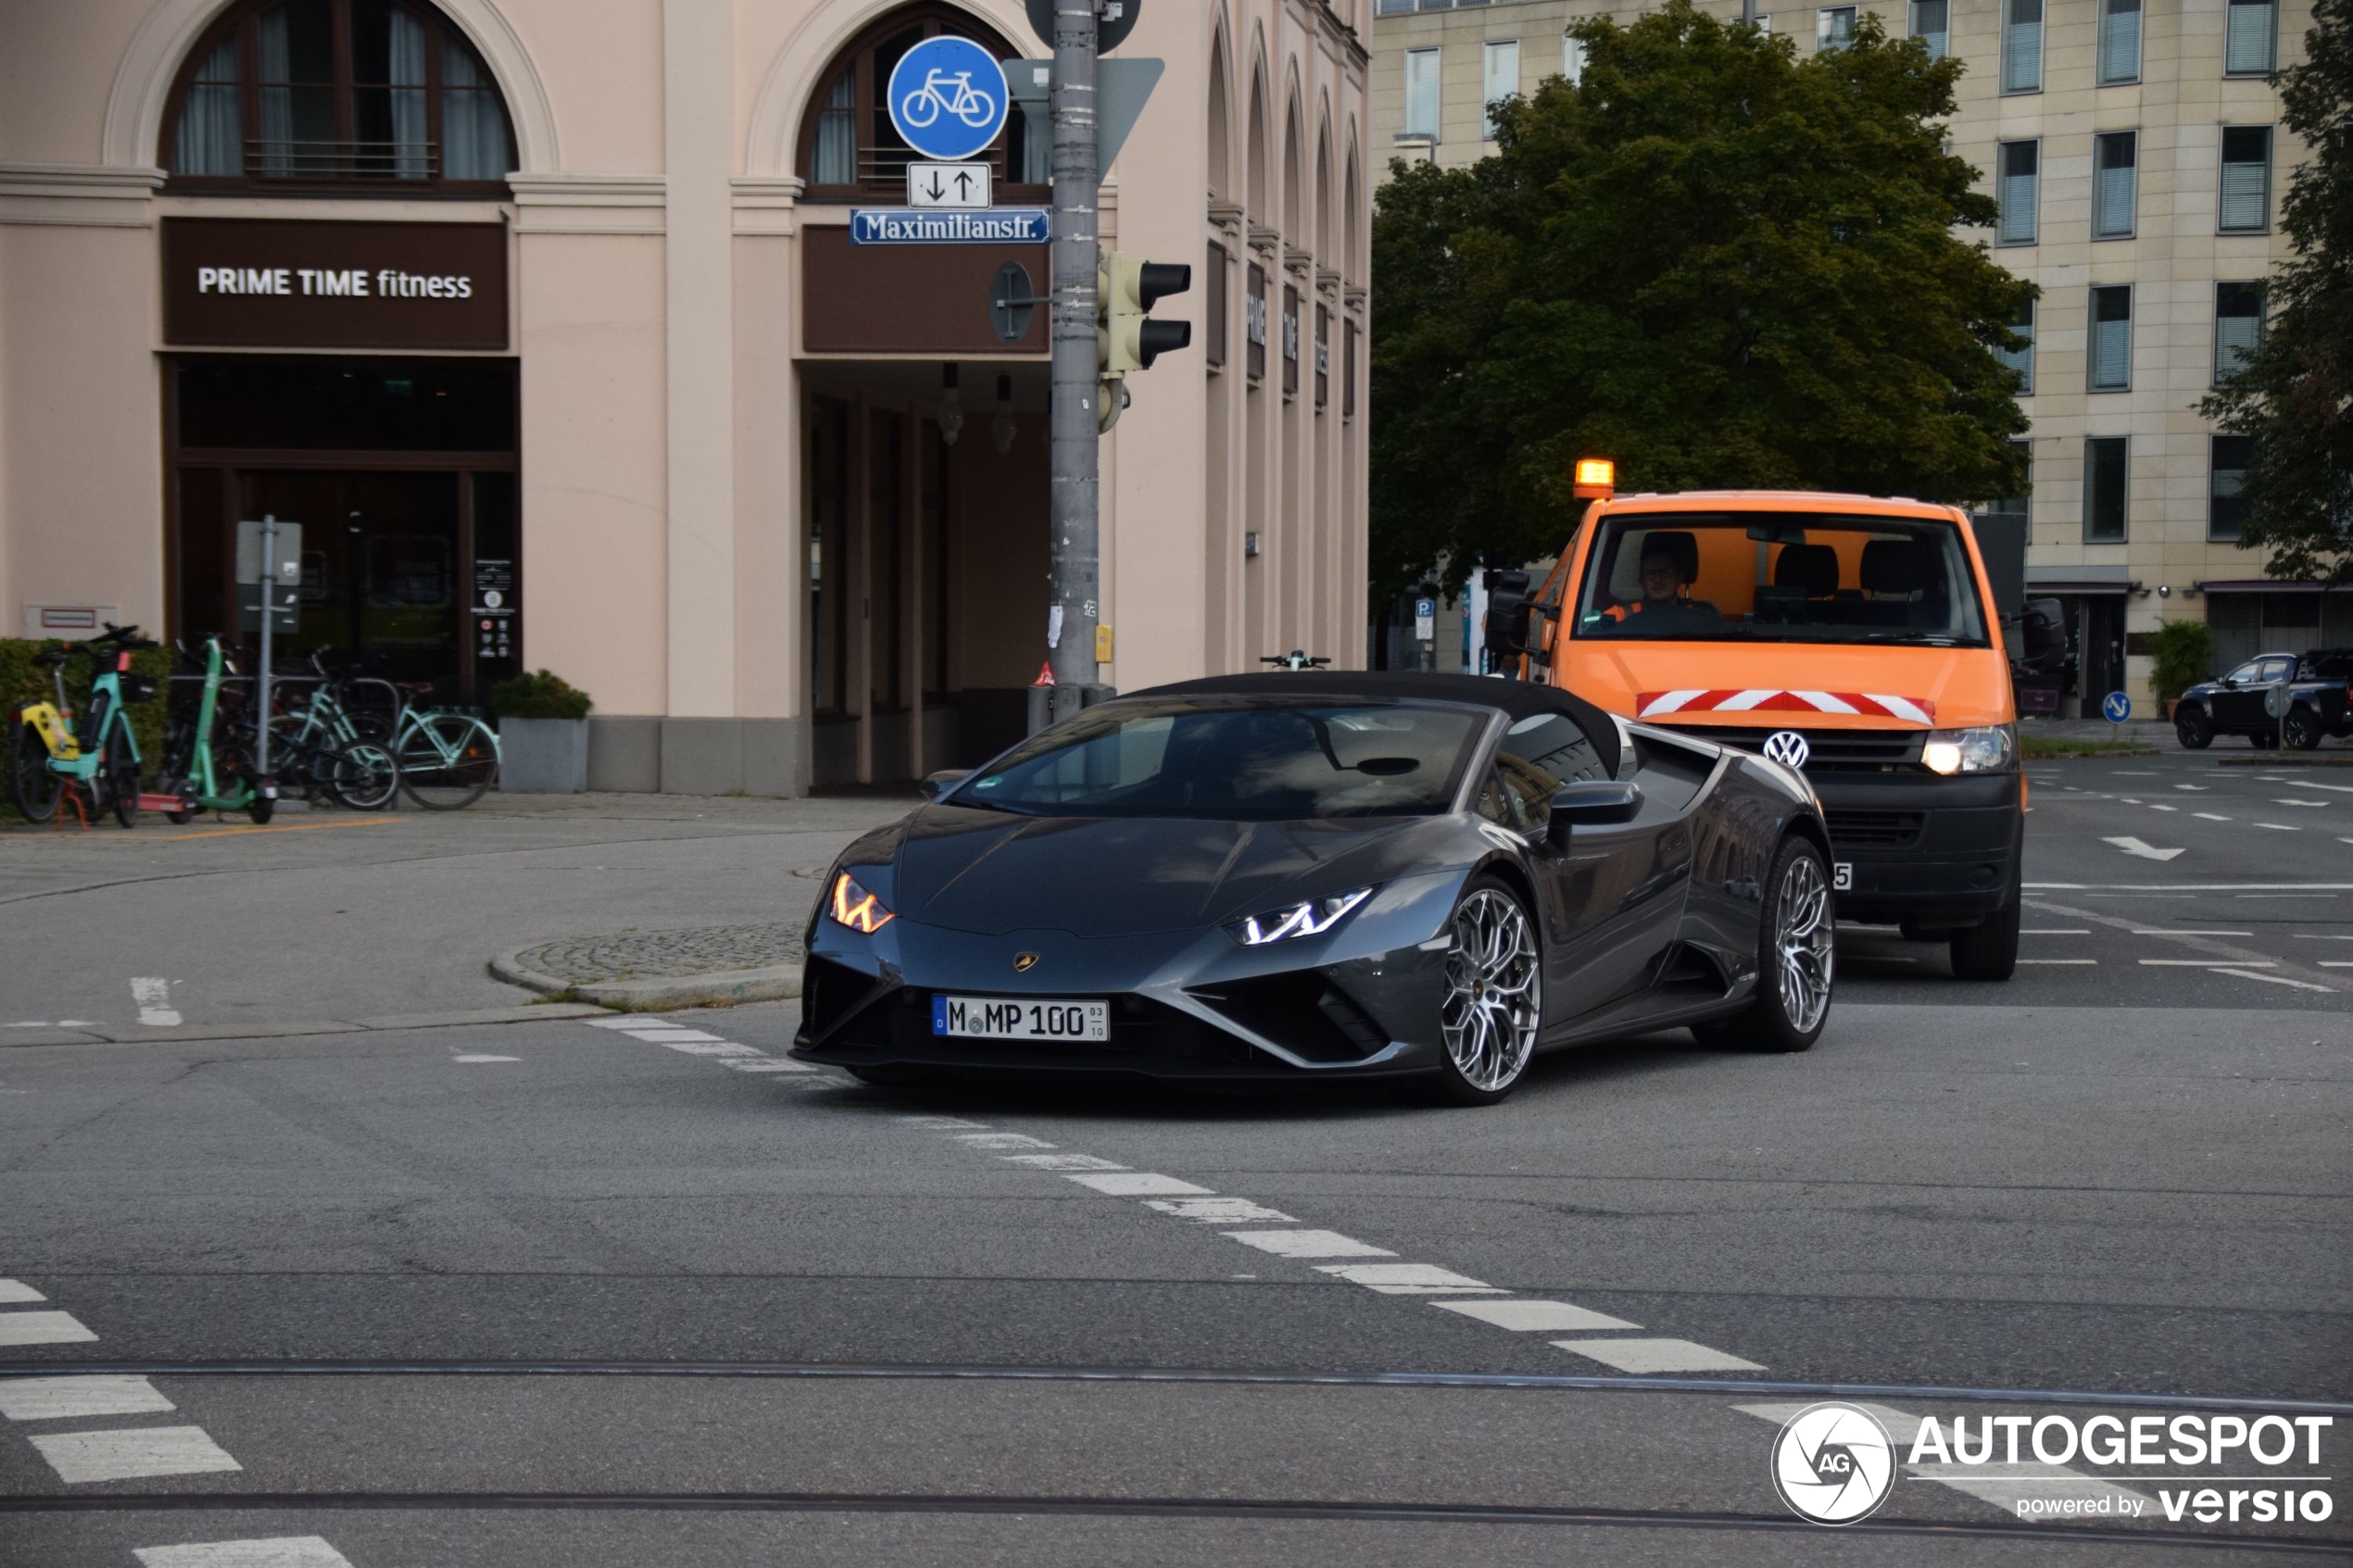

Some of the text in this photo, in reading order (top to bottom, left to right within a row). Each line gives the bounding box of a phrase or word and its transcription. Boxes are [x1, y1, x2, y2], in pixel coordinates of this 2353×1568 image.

[865, 214, 1037, 240] Maximilianstr.
[197, 268, 472, 299] PRIME TIME fitness
[949, 1001, 1084, 1035] M MP 100
